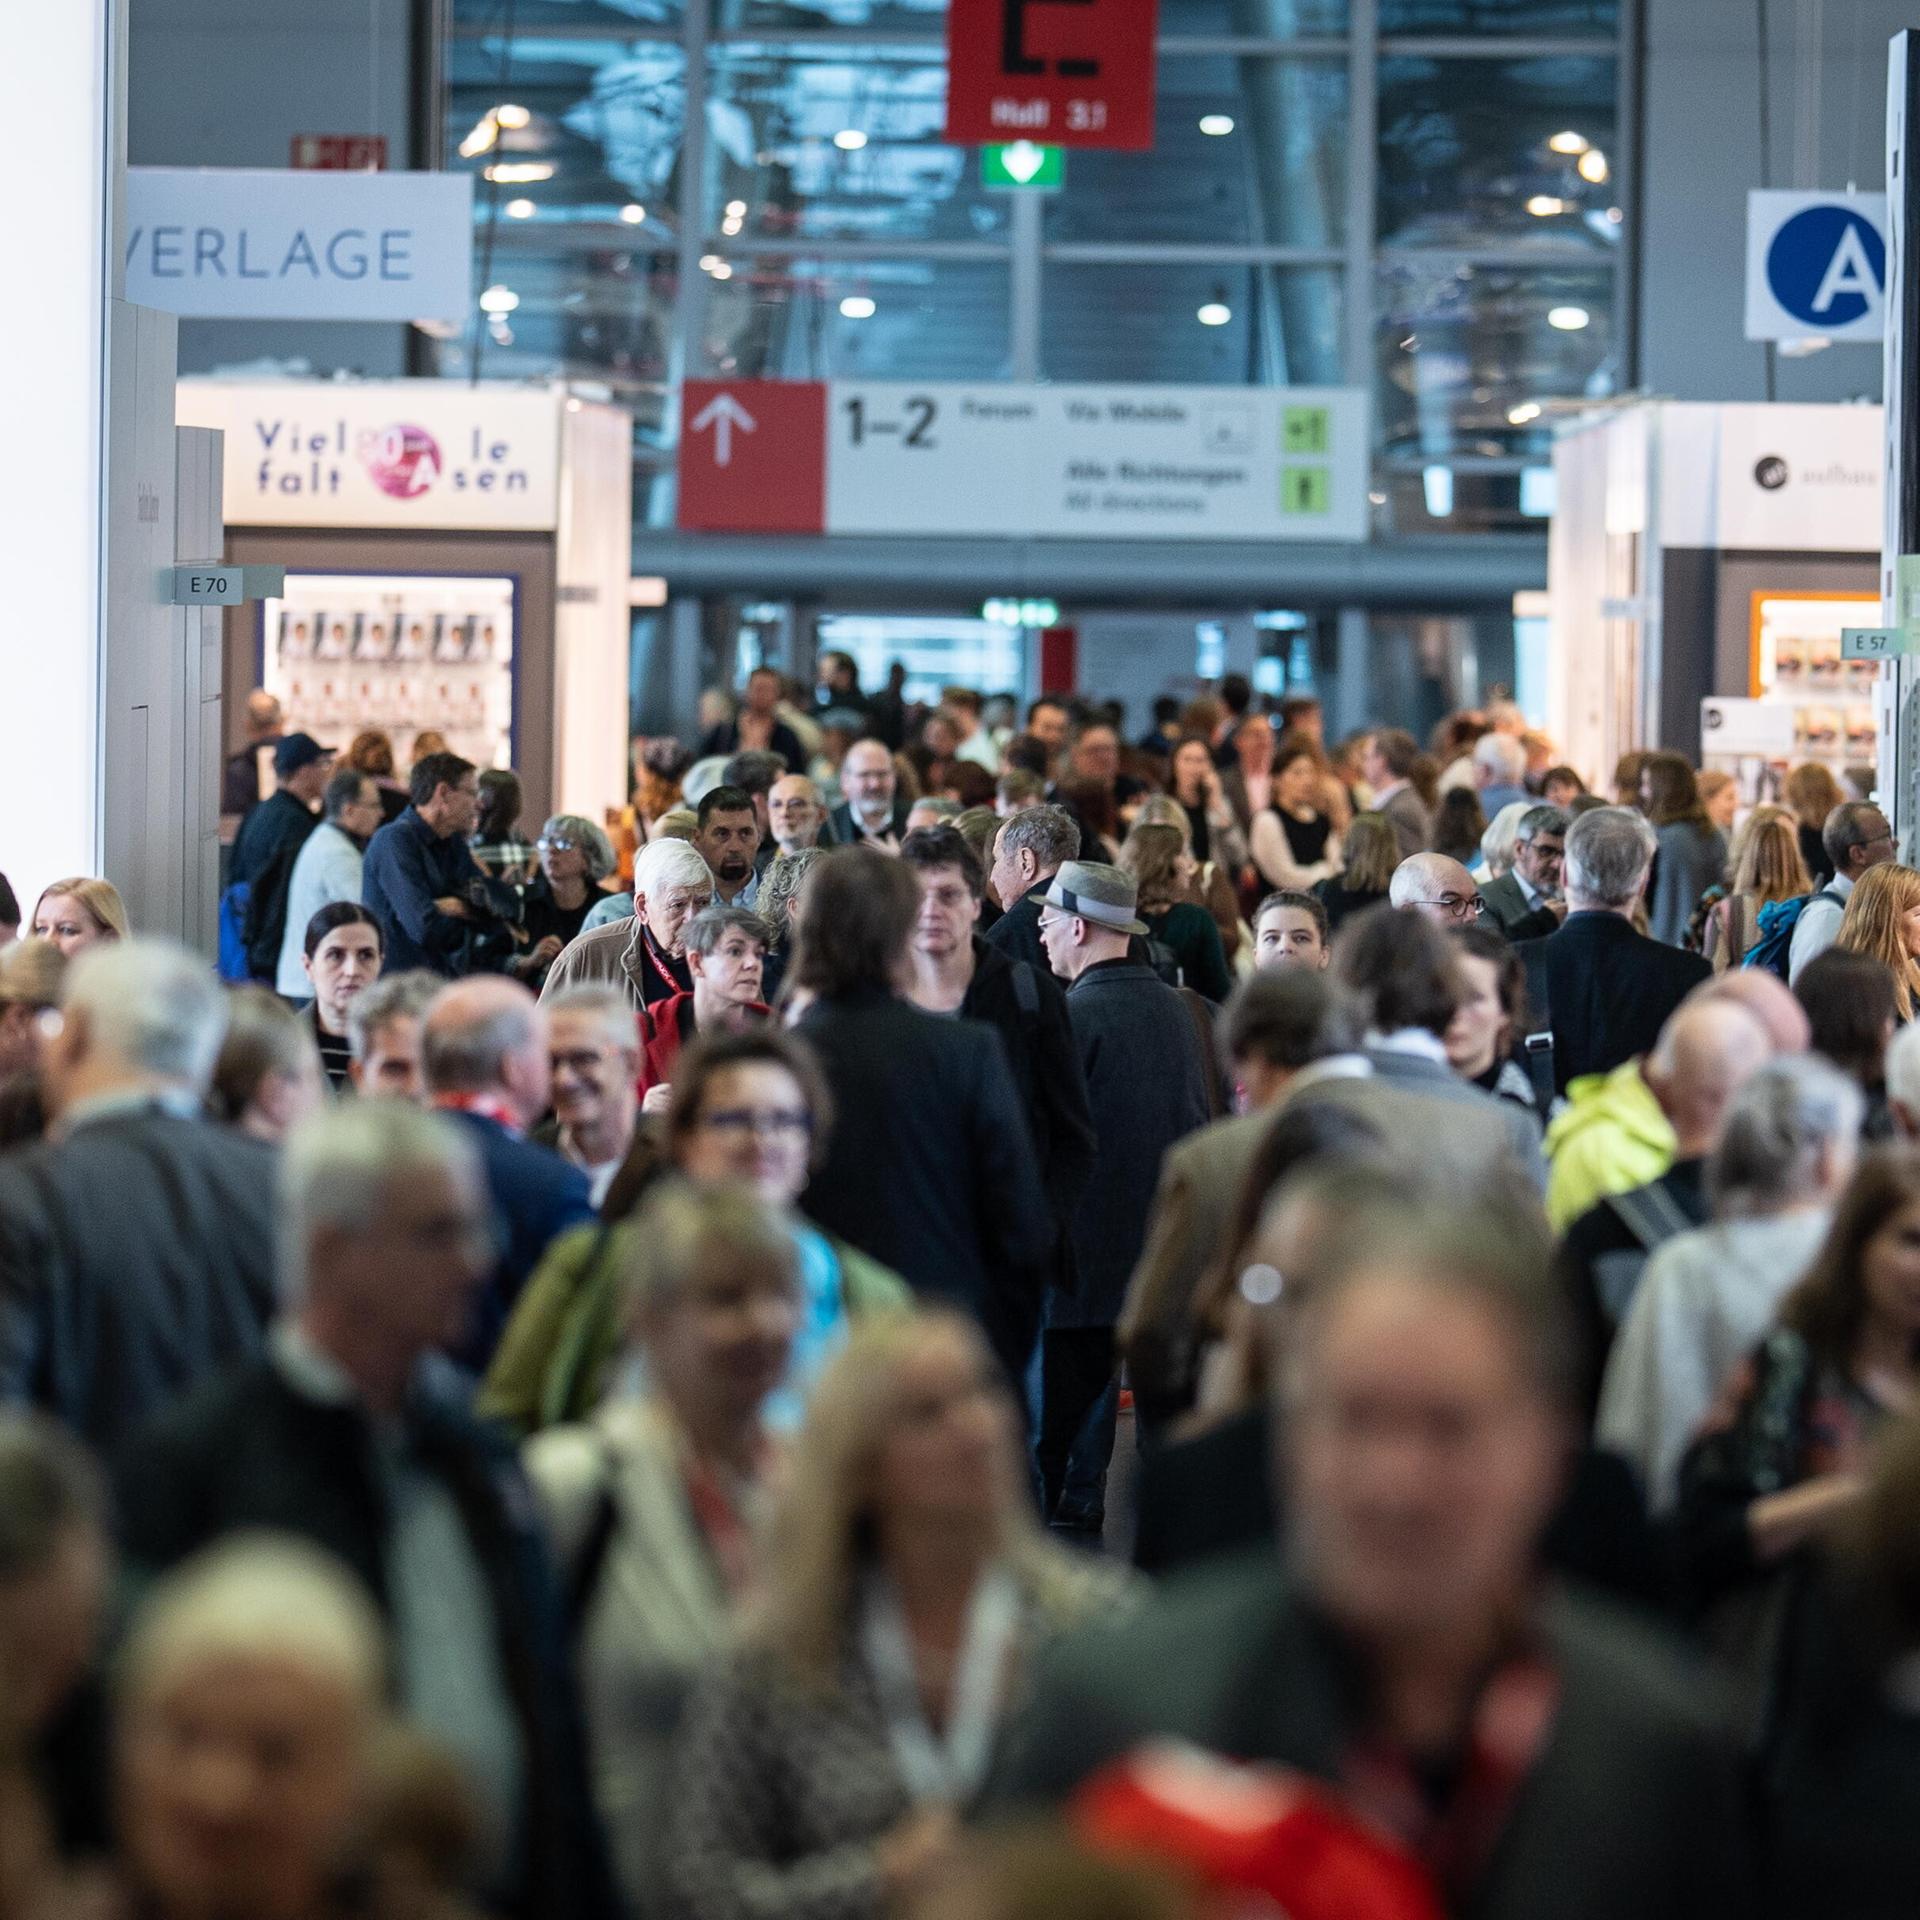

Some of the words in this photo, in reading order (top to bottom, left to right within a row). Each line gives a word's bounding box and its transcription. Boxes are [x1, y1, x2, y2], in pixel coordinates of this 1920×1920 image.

[1810, 221, 1885, 313] A
[255, 420, 346, 455] Viel
[472, 427, 510, 463] le
[258, 459, 338, 495] falt
[453, 469, 528, 493] sen
[1119, 458, 1243, 488] Richtungen
[191, 577, 201, 593] E
[206, 577, 228, 594] 70
[1856, 635, 1864, 650] E
[1870, 636, 1887, 651] 57
